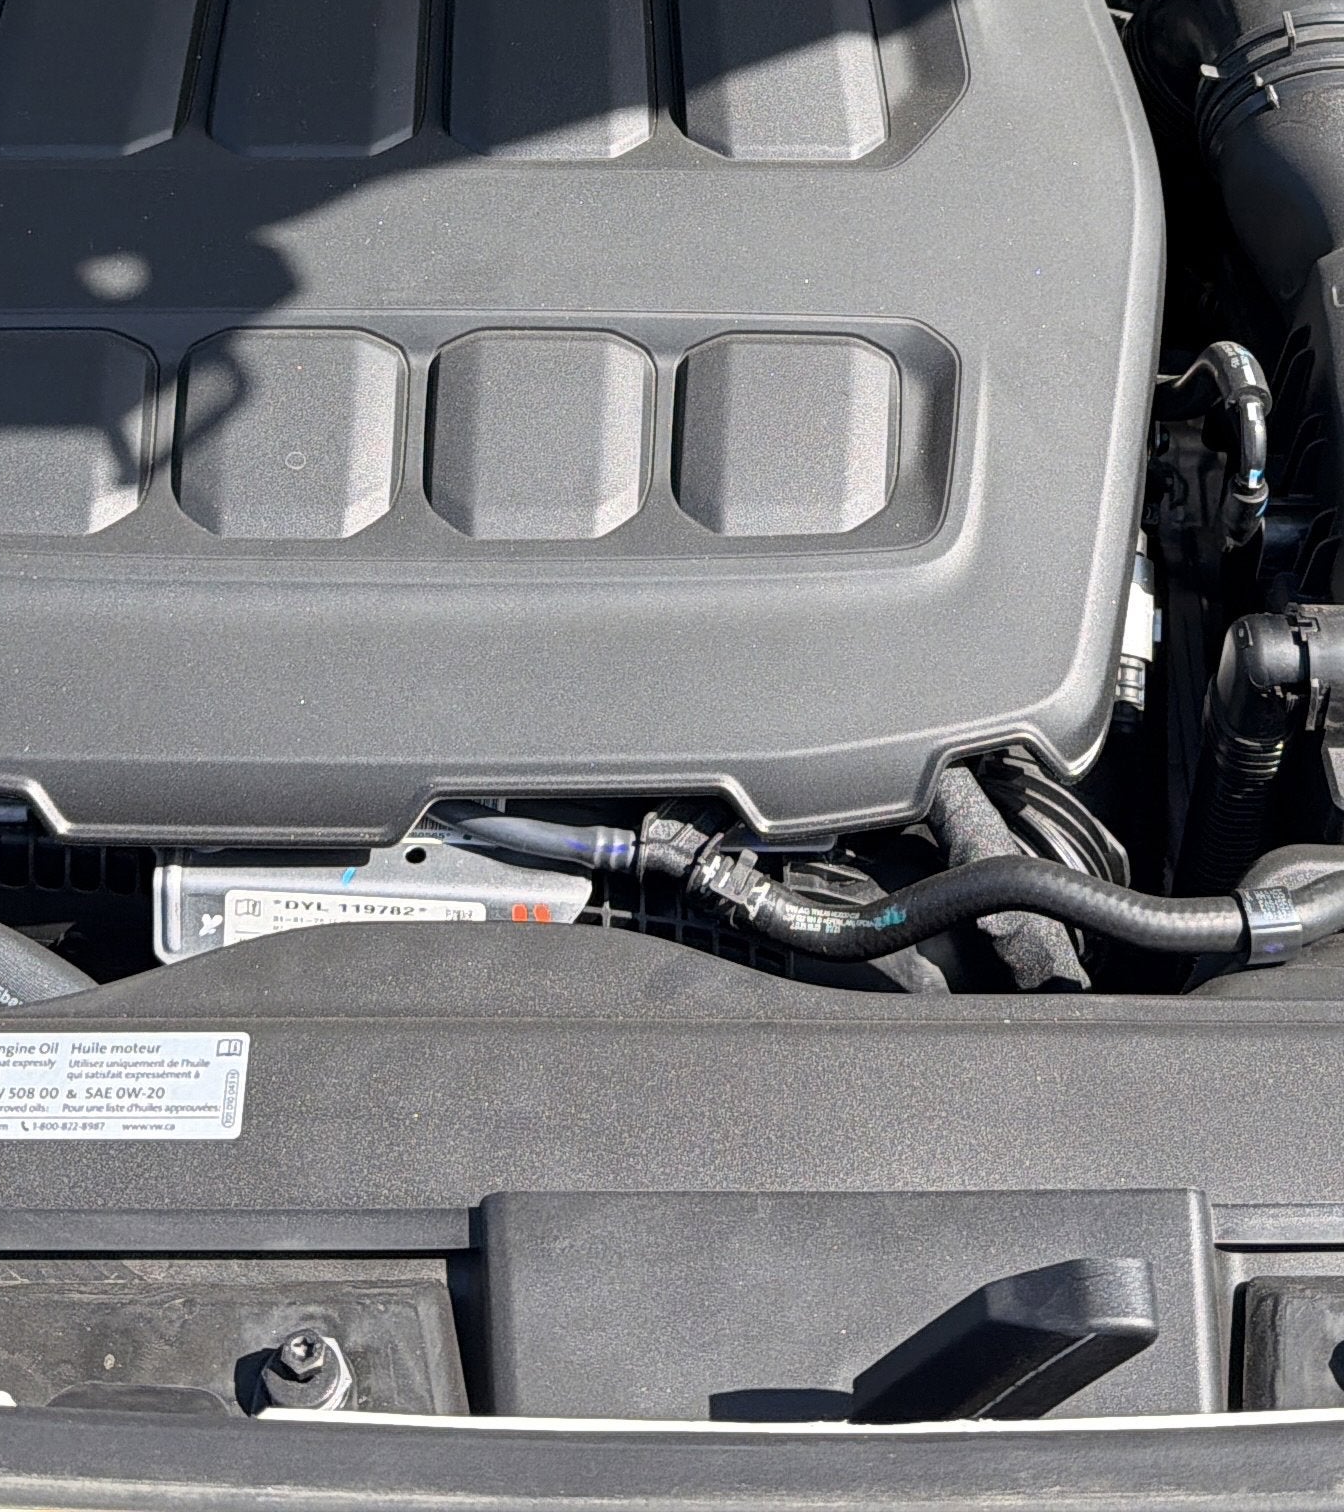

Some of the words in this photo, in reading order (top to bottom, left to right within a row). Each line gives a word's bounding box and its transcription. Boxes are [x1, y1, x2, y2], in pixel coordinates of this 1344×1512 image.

[39, 1042, 60, 1055] Oil
[70, 1042, 108, 1055] Huile
[110, 1042, 162, 1055] moteur
[12, 1058, 57, 1070] expressly
[106, 1059, 165, 1070] uniquement
[166, 1058, 179, 1068] de
[66, 1070, 83, 1080] qui
[8, 1087, 35, 1100] 508
[39, 1087, 60, 1100] 00
[66, 1089, 77, 1100] &
[85, 1087, 113, 1100] SAE
[116, 1087, 166, 1100] 0W-20
[62, 1103, 84, 1113] Pour
